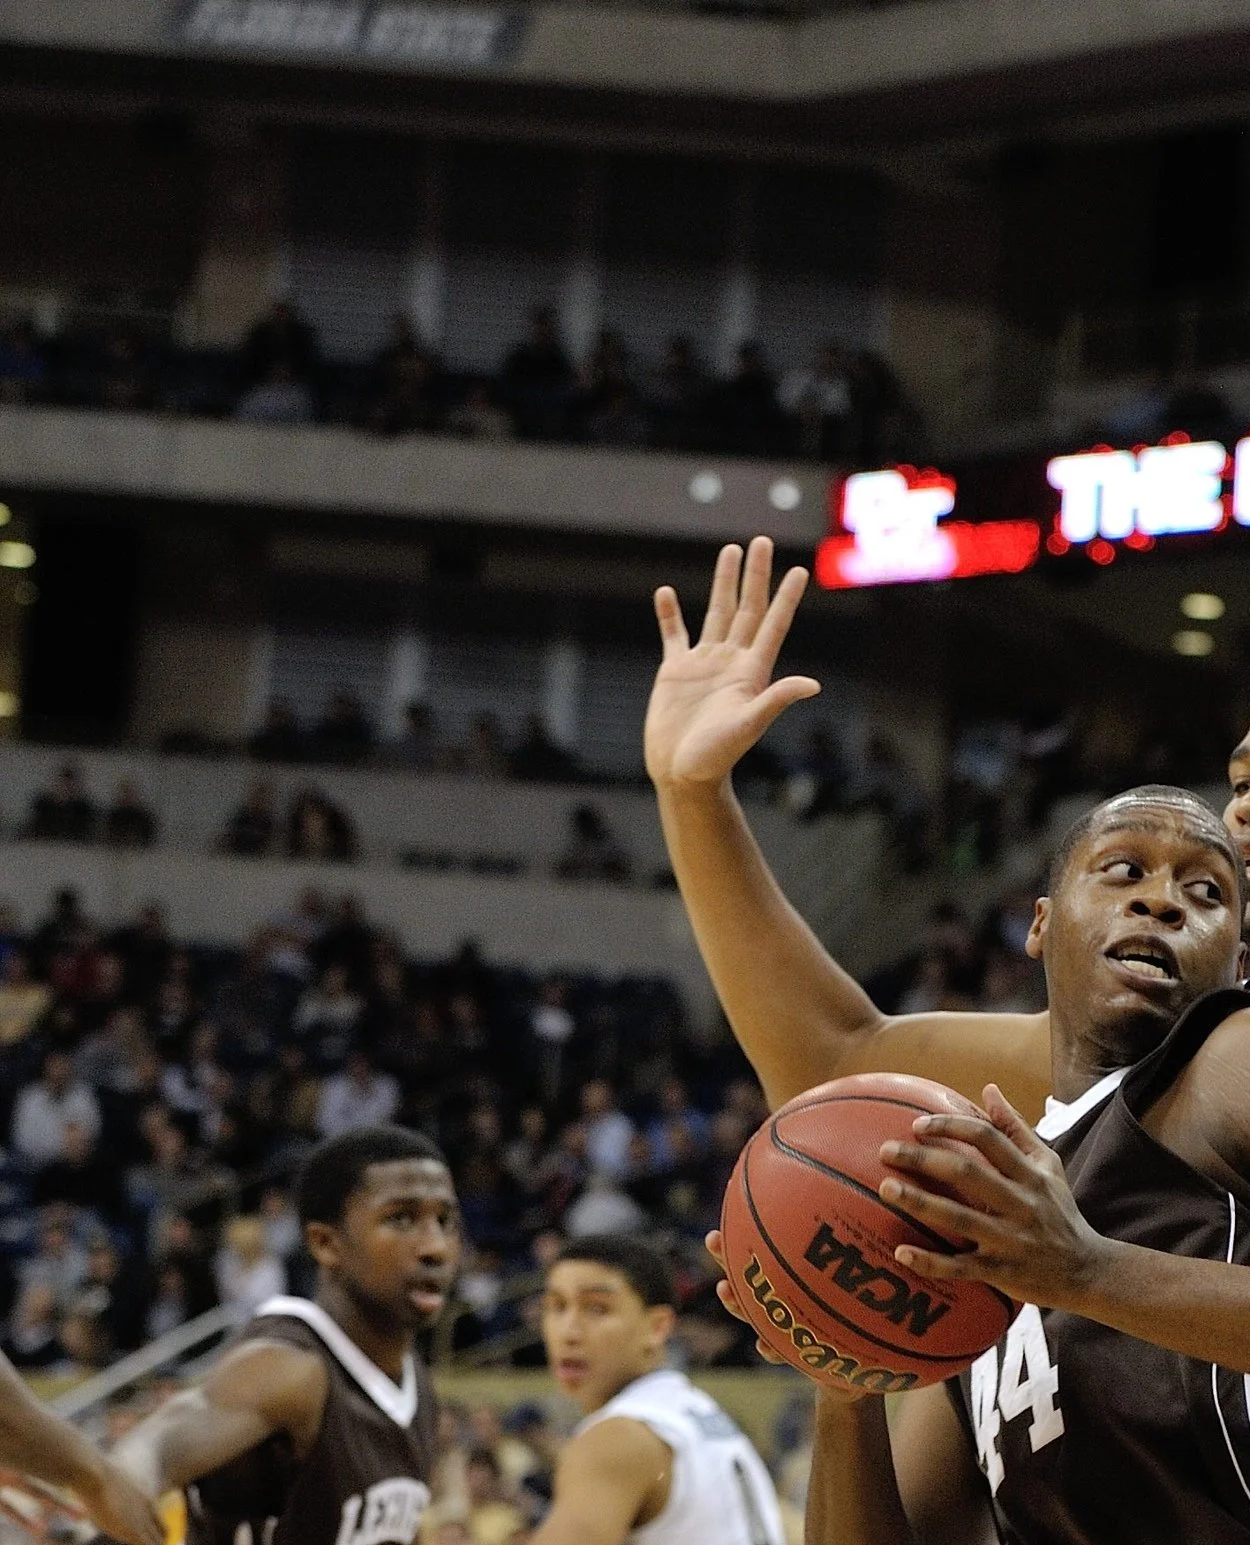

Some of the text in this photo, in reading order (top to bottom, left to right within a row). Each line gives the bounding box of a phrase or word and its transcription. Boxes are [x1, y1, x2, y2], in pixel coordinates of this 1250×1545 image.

[1047, 441, 1224, 542] THE
[804, 1222, 950, 1337] NCAA
[971, 1303, 1065, 1498] 44
